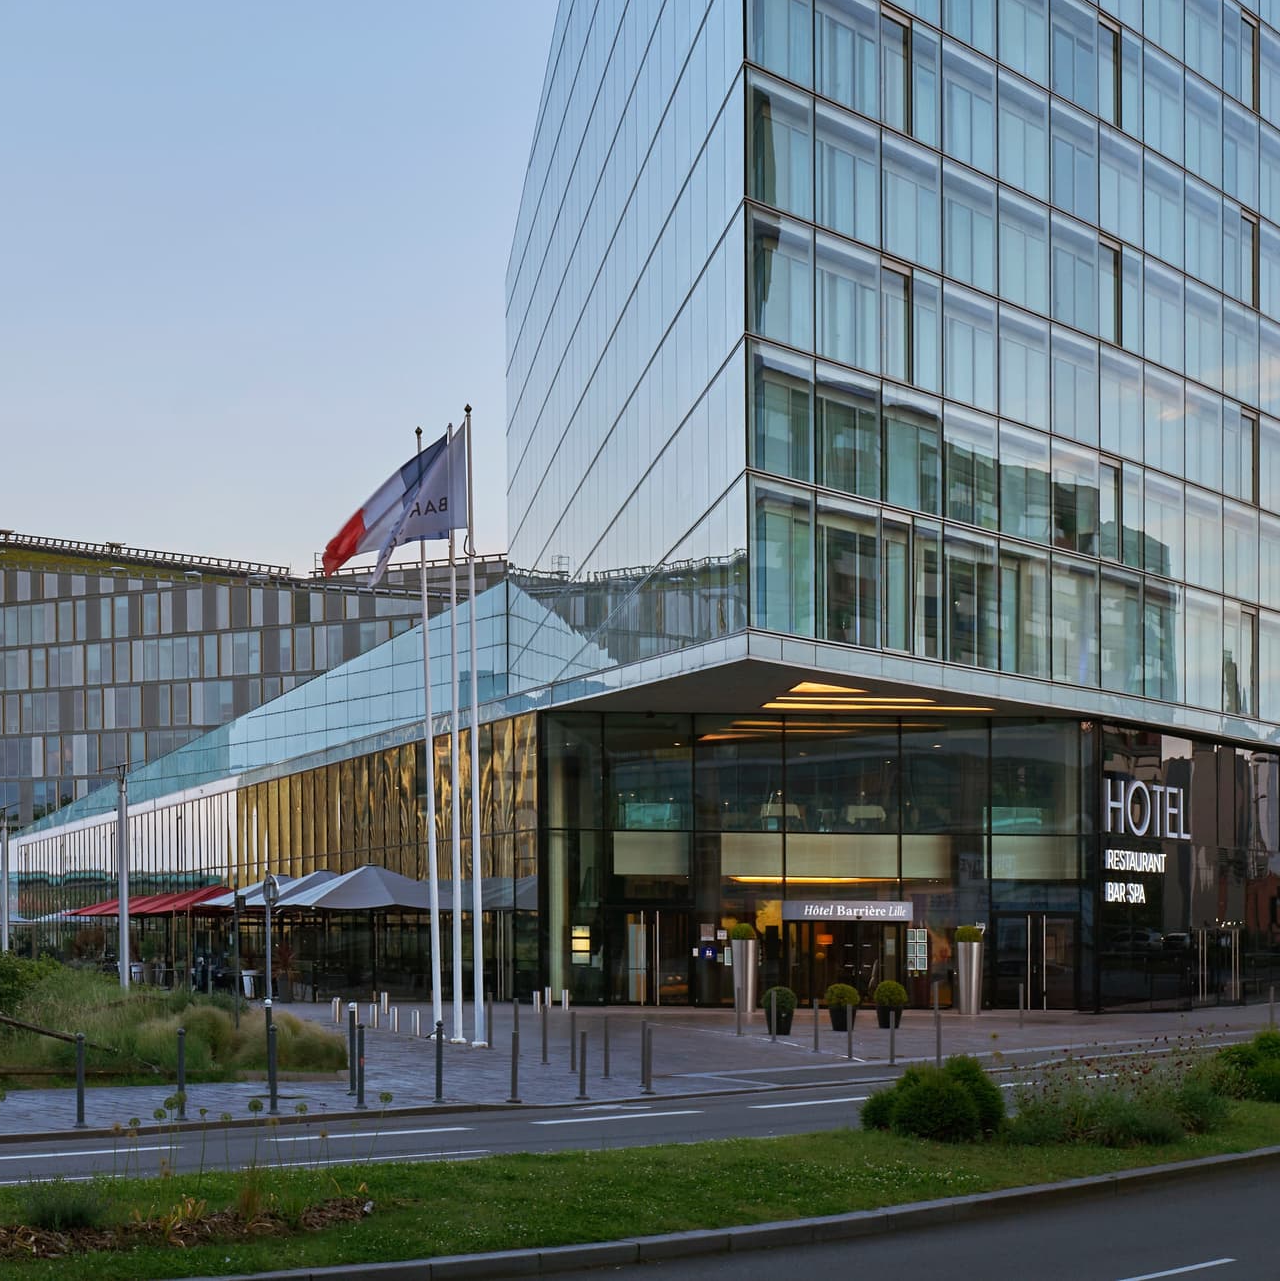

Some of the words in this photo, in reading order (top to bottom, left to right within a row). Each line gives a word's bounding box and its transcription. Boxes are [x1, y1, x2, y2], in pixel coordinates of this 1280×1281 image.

[1105, 778, 1191, 840] HOTEL
[1105, 849, 1167, 873] RESTAURANT
[1105, 882, 1126, 903] BAR
[1127, 883, 1146, 904] SPA
[804, 904, 833, 916] Hôtel
[837, 905, 886, 917] Barrière
[888, 906, 907, 917] Lille
